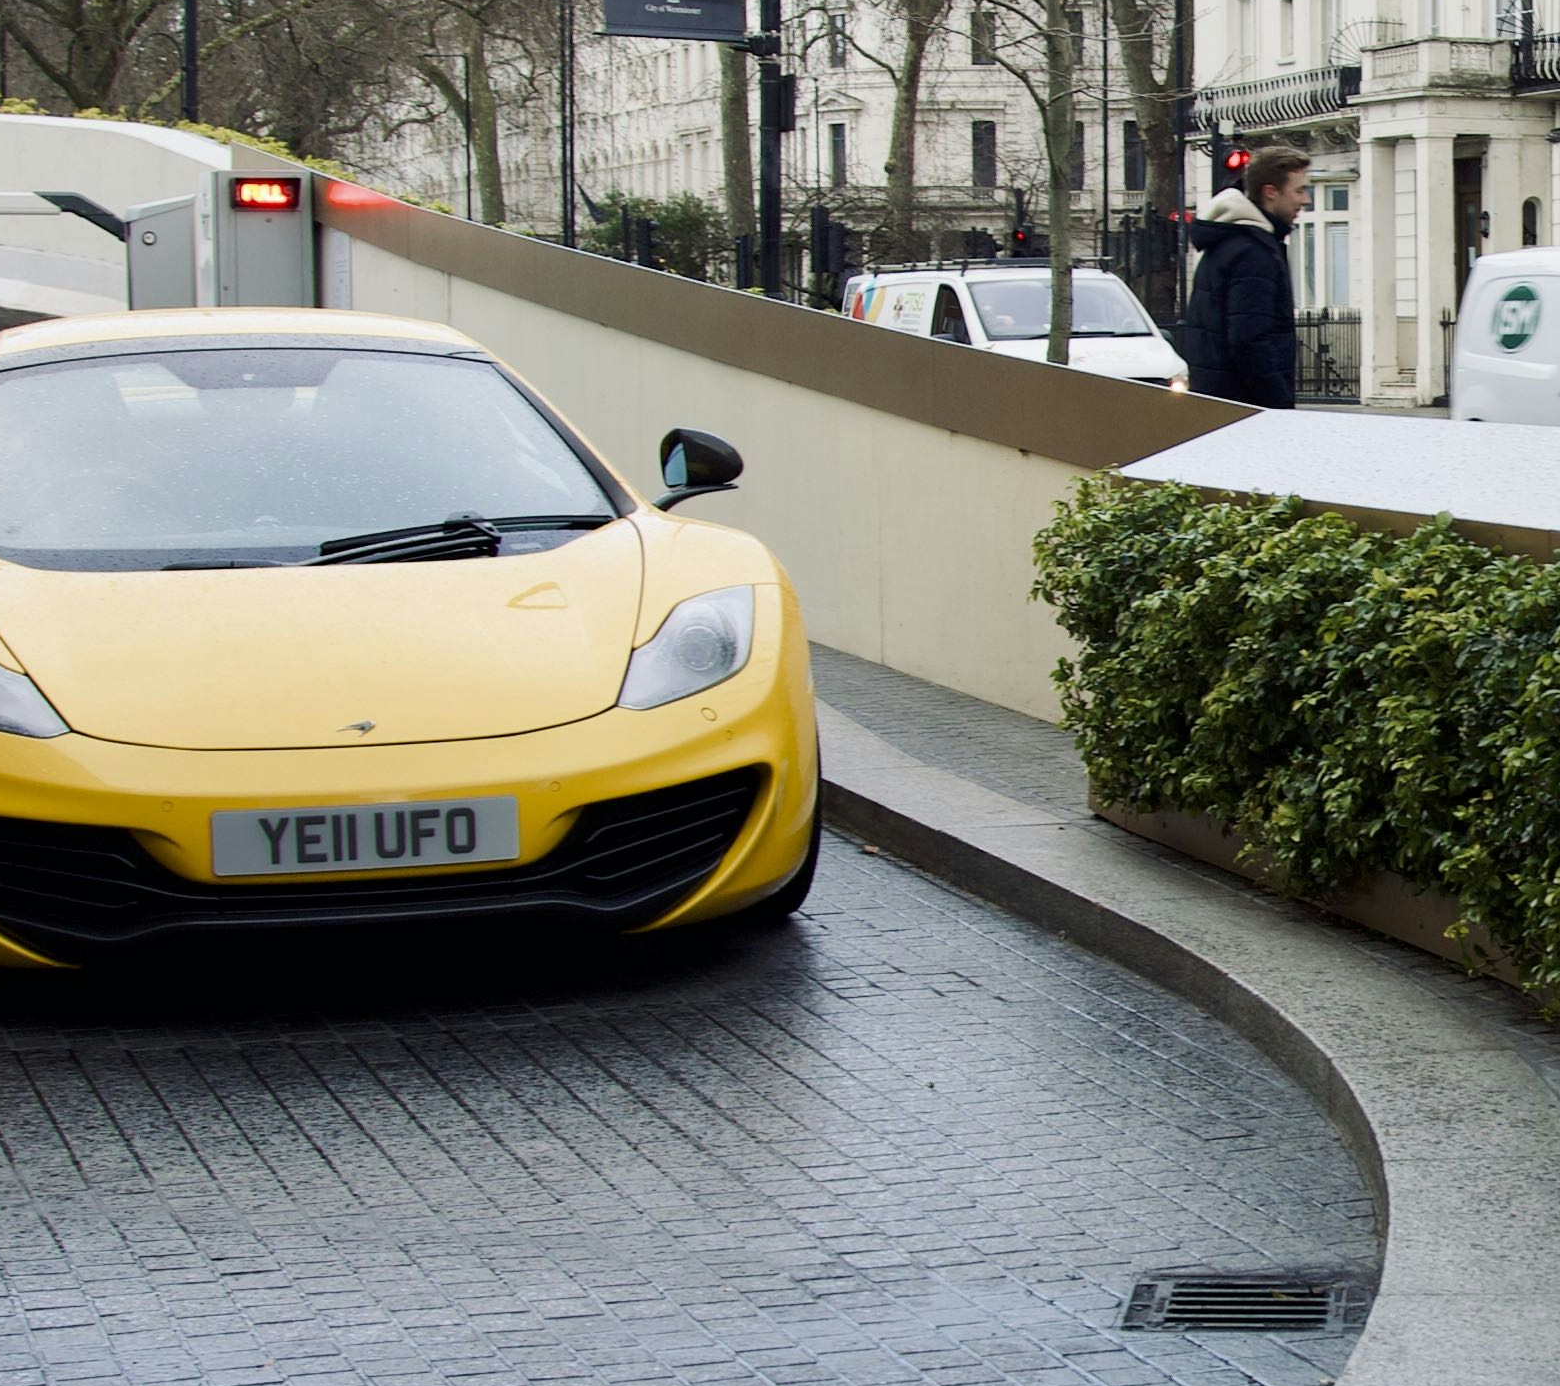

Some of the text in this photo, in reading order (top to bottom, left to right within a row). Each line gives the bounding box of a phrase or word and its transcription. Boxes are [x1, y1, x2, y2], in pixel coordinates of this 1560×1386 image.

[241, 183, 288, 203] FULL
[258, 807, 477, 865] YE11 UFO
